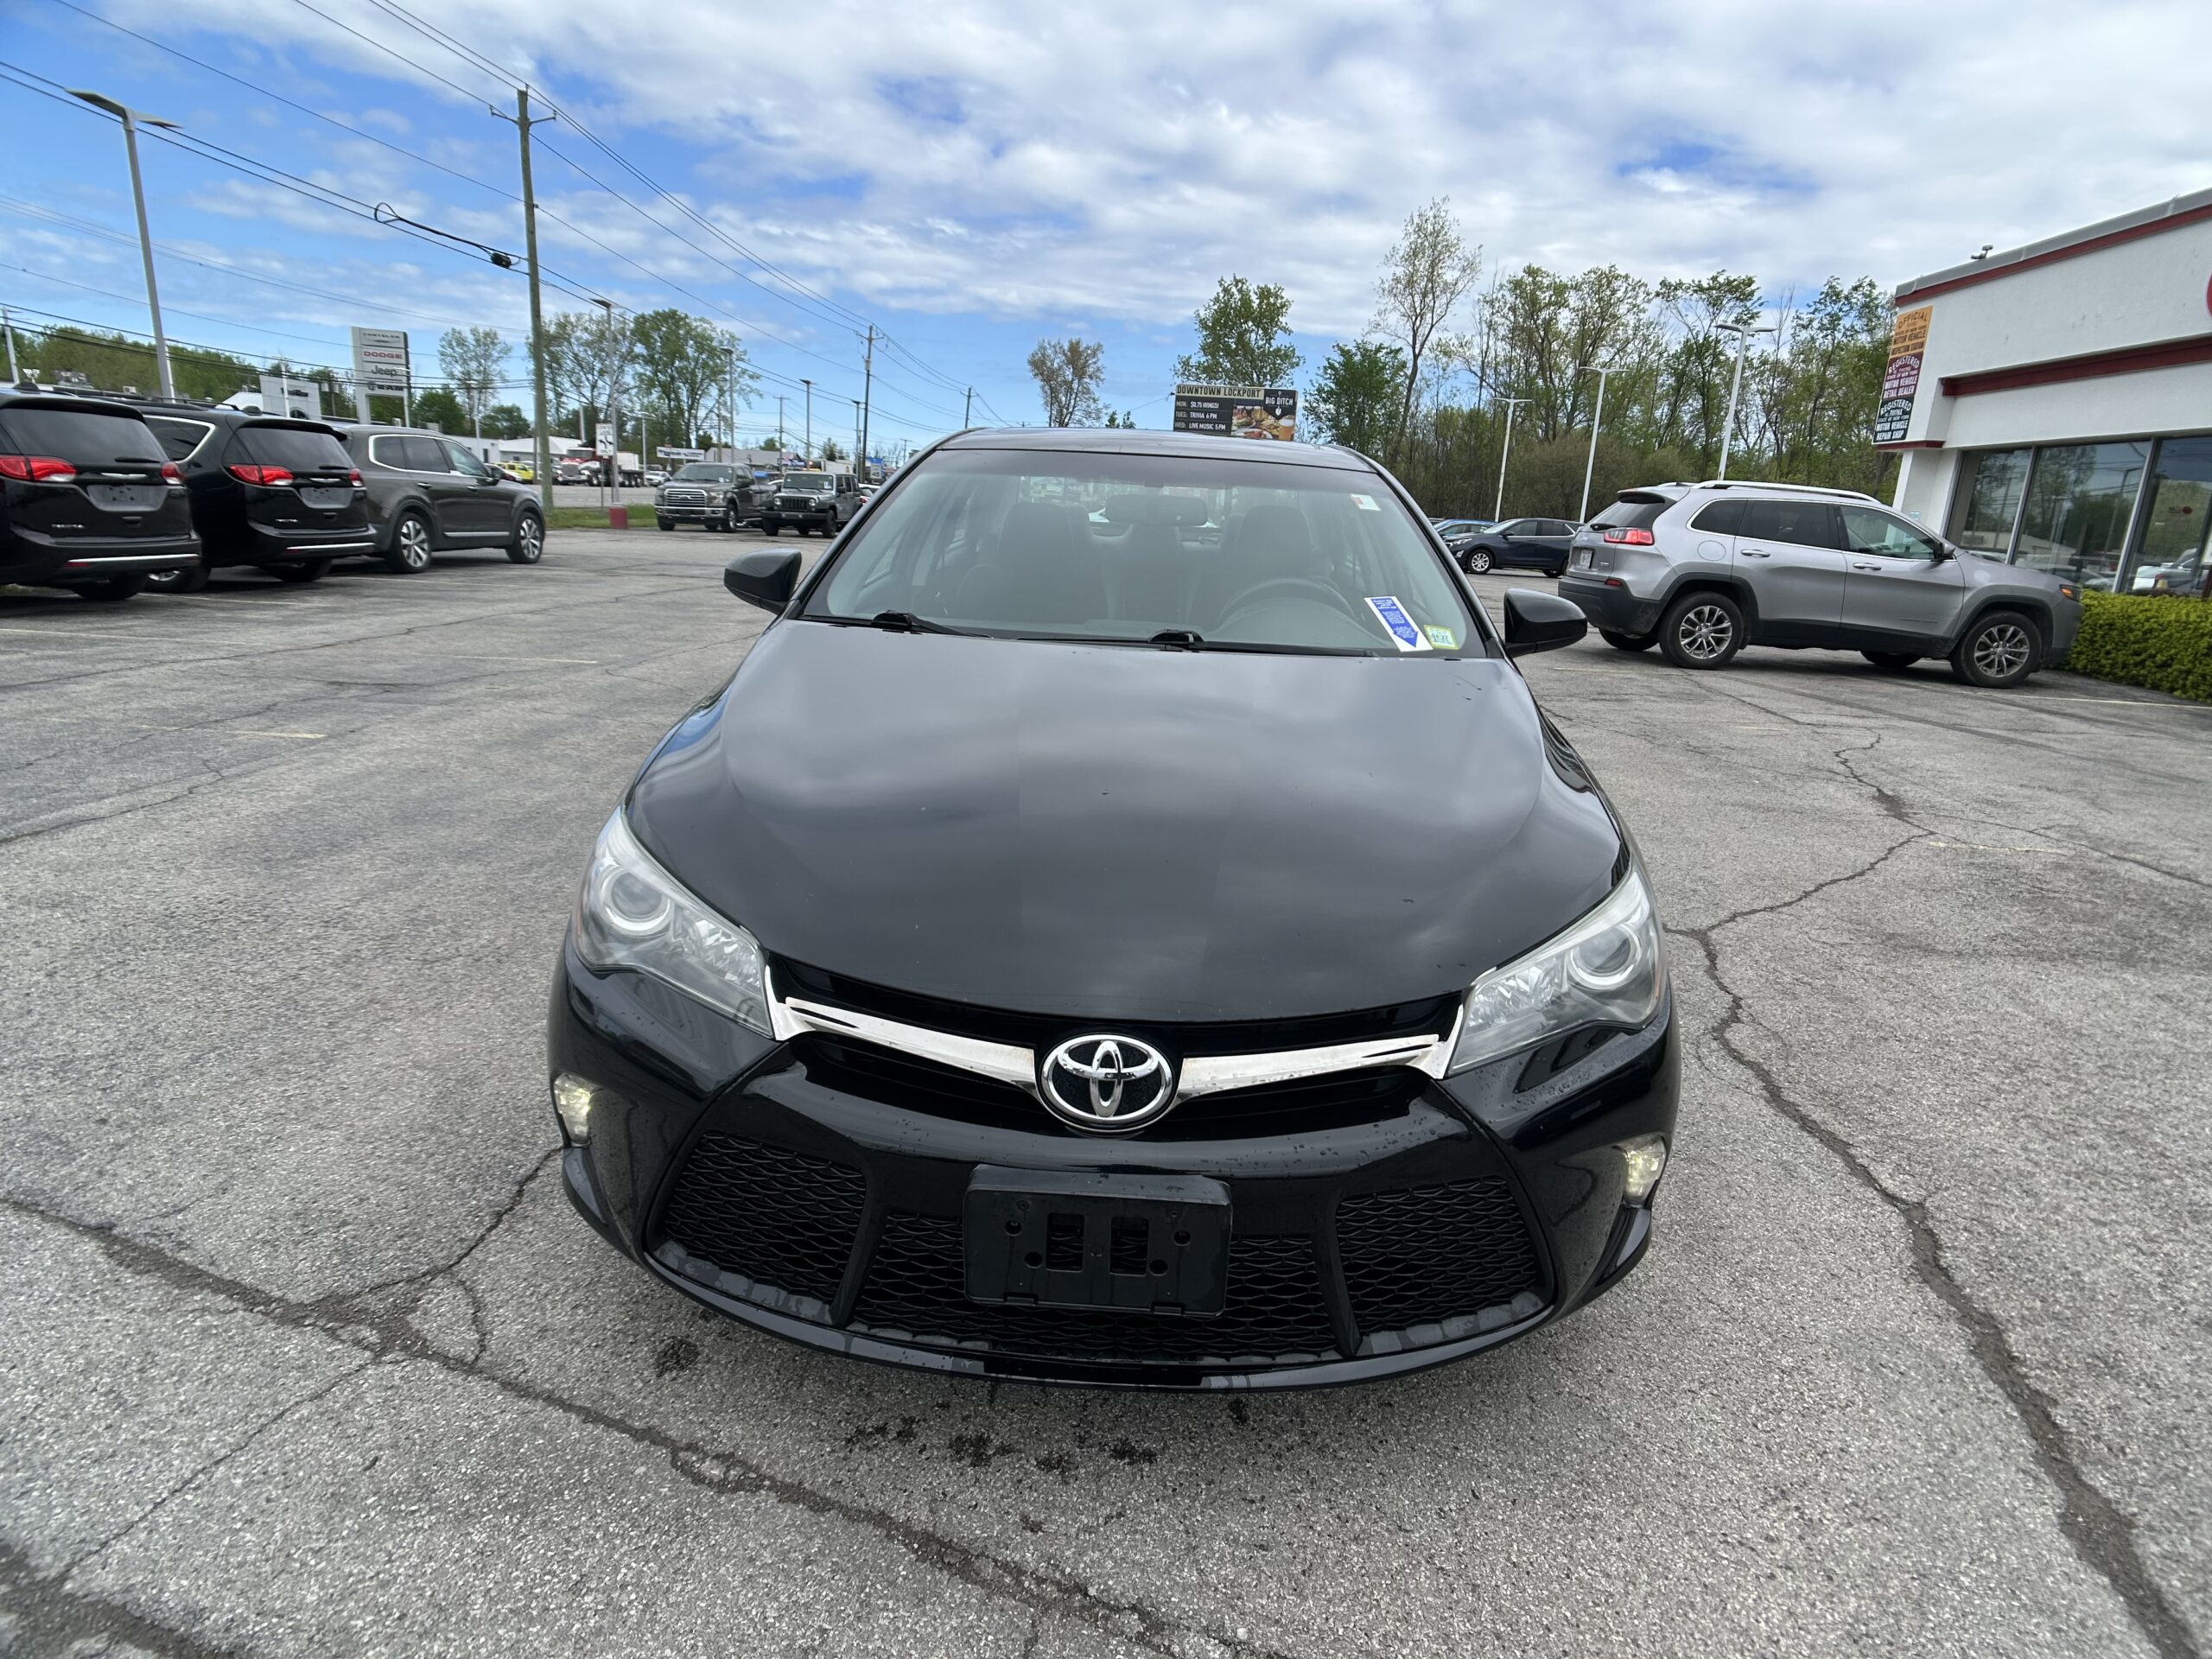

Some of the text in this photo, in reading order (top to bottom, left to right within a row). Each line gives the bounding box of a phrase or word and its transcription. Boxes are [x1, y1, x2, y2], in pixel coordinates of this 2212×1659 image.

[1897, 311, 1928, 329] OFFICIAL
[1908, 329, 1927, 341] VEHICLE
[372, 365, 397, 377] Jeep
[1888, 355, 1920, 375] REGISTERED
[1885, 375, 1918, 390] MOTOR VEHICLE
[1177, 385, 1261, 397] DOWNTOWN LOCKPORT
[1884, 385, 1915, 398] RETAIL DEALER
[1265, 397, 1294, 406] BIG DITCH
[1880, 398, 1911, 416] REGISTERED
[1876, 419, 1909, 431] MOTOR VEHICLE
[1876, 429, 1904, 441] REPAIR SHOP
